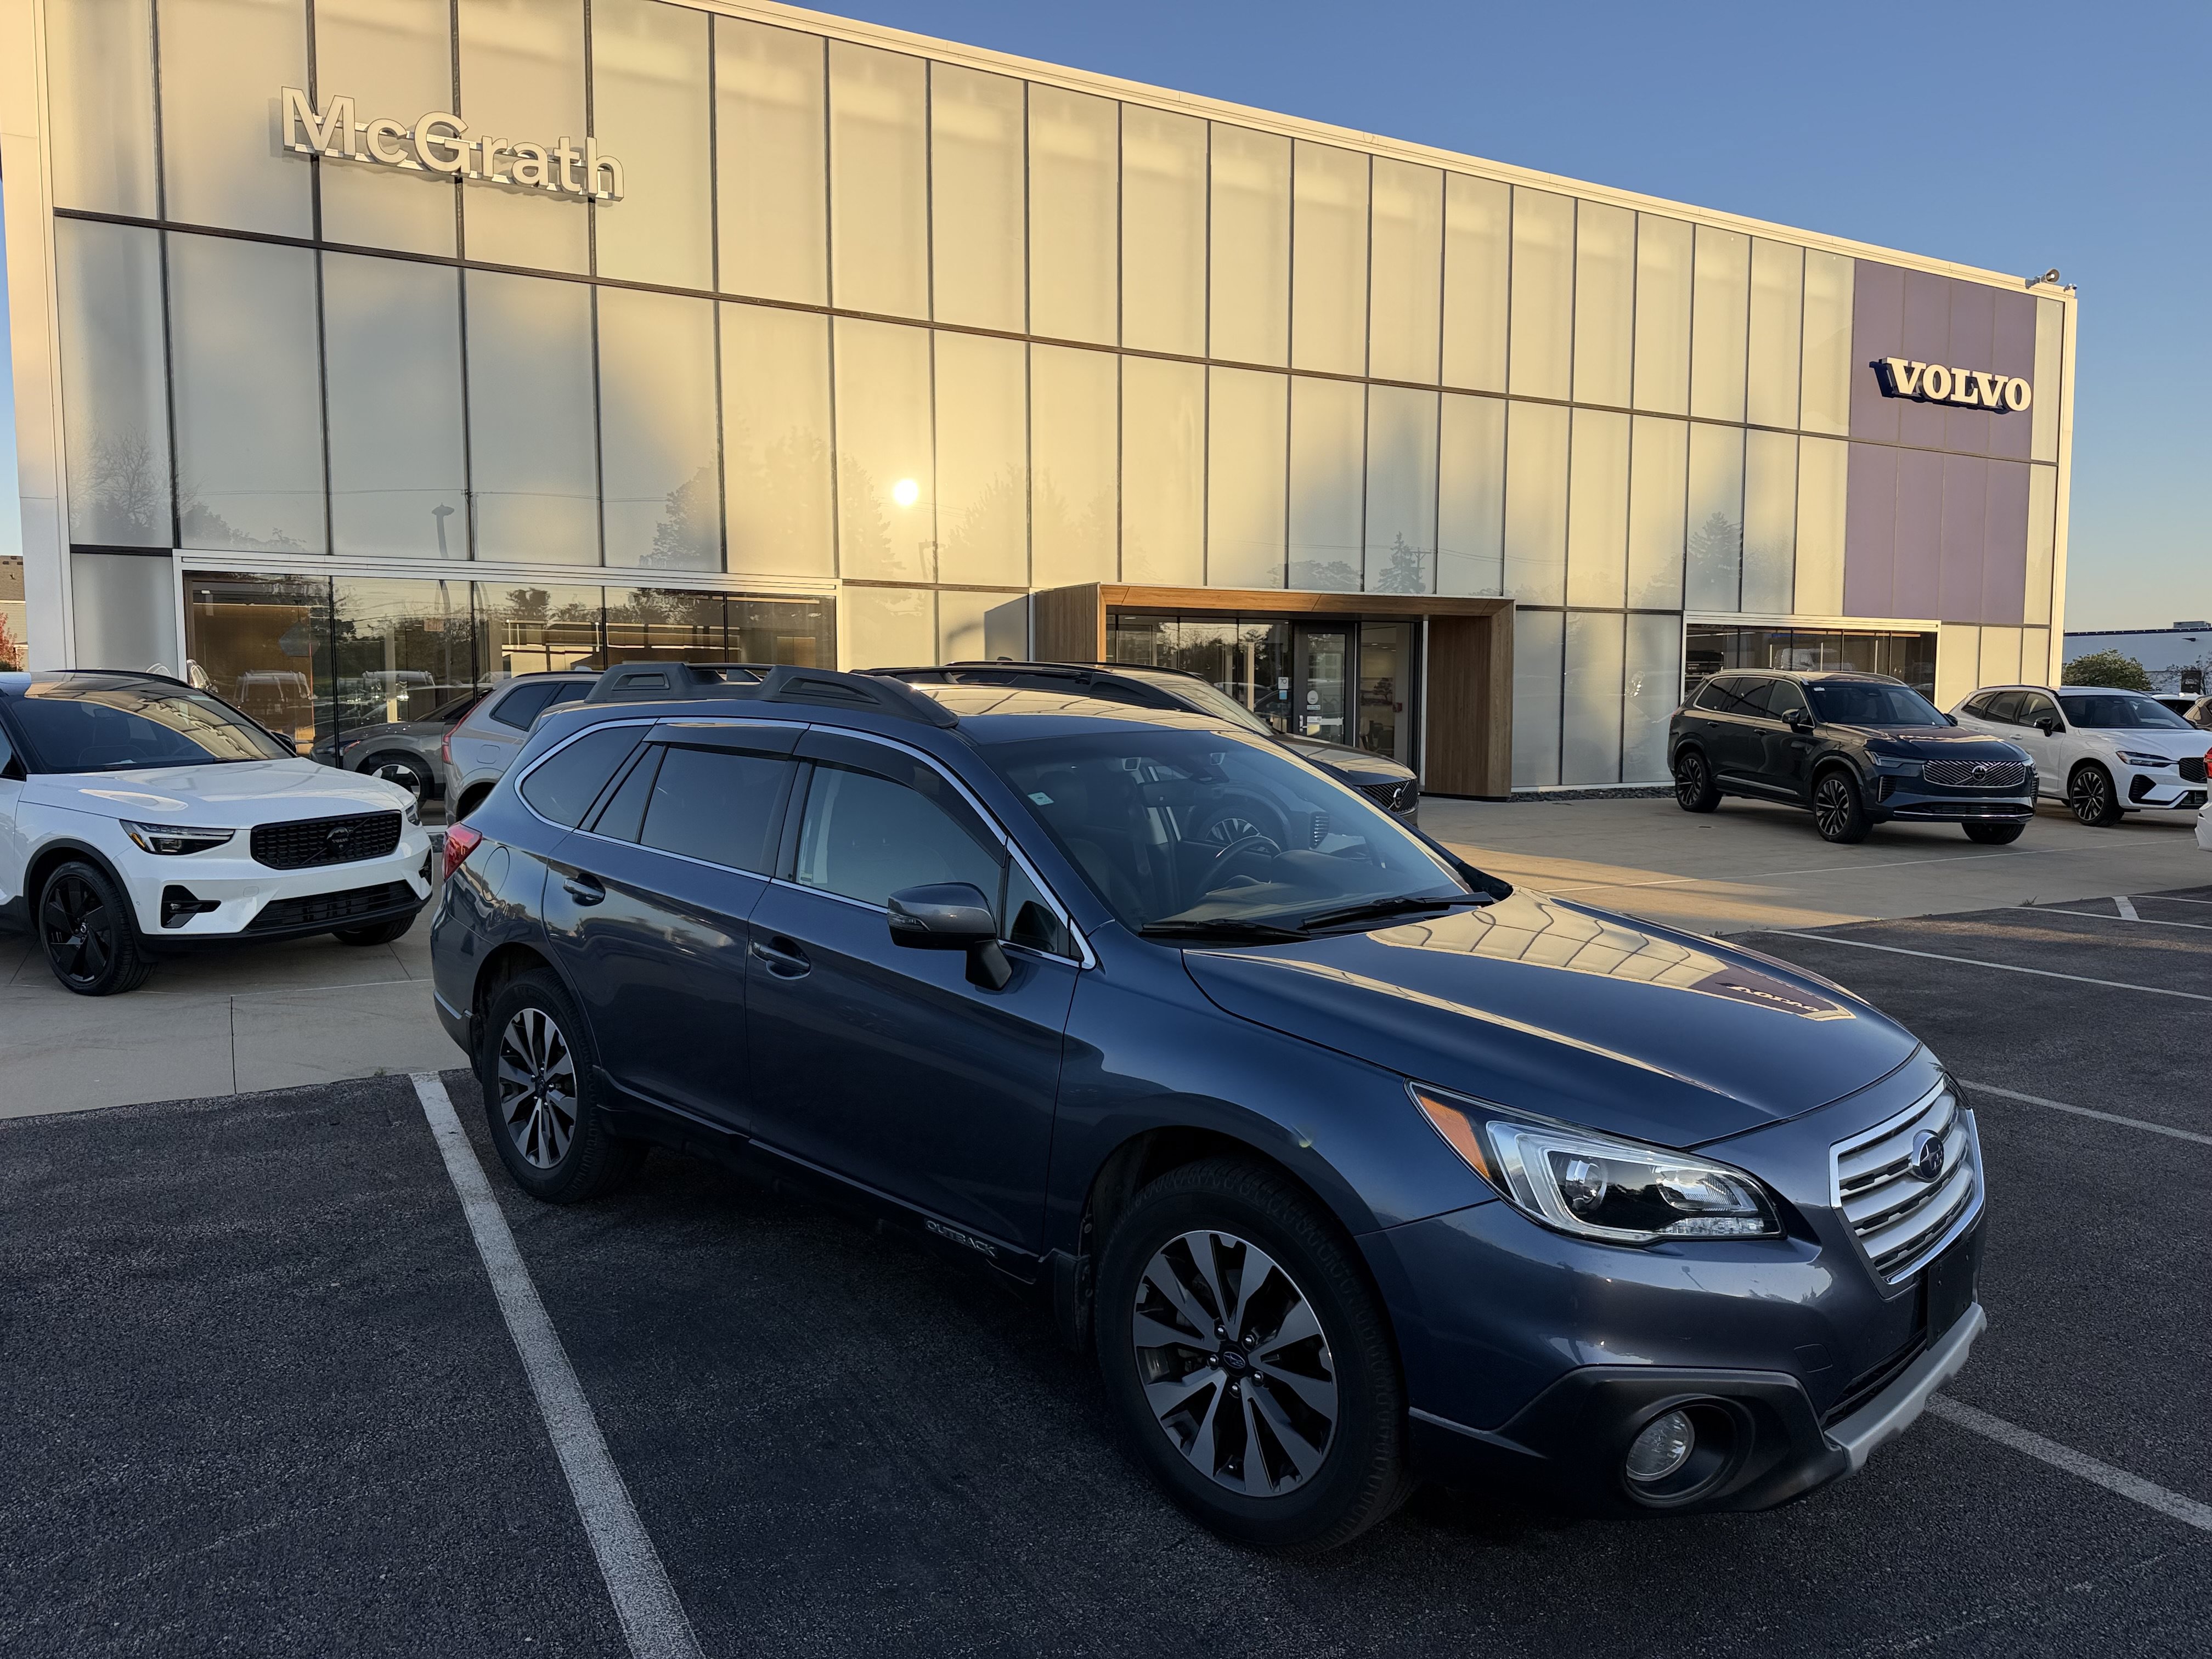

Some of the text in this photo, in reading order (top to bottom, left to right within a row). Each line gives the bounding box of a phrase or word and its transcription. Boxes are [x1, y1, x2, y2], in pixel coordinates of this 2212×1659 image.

[281, 86, 624, 201] McGrath
[1886, 356, 2032, 411] VOLVO
[926, 1220, 996, 1257] OUTBACK
